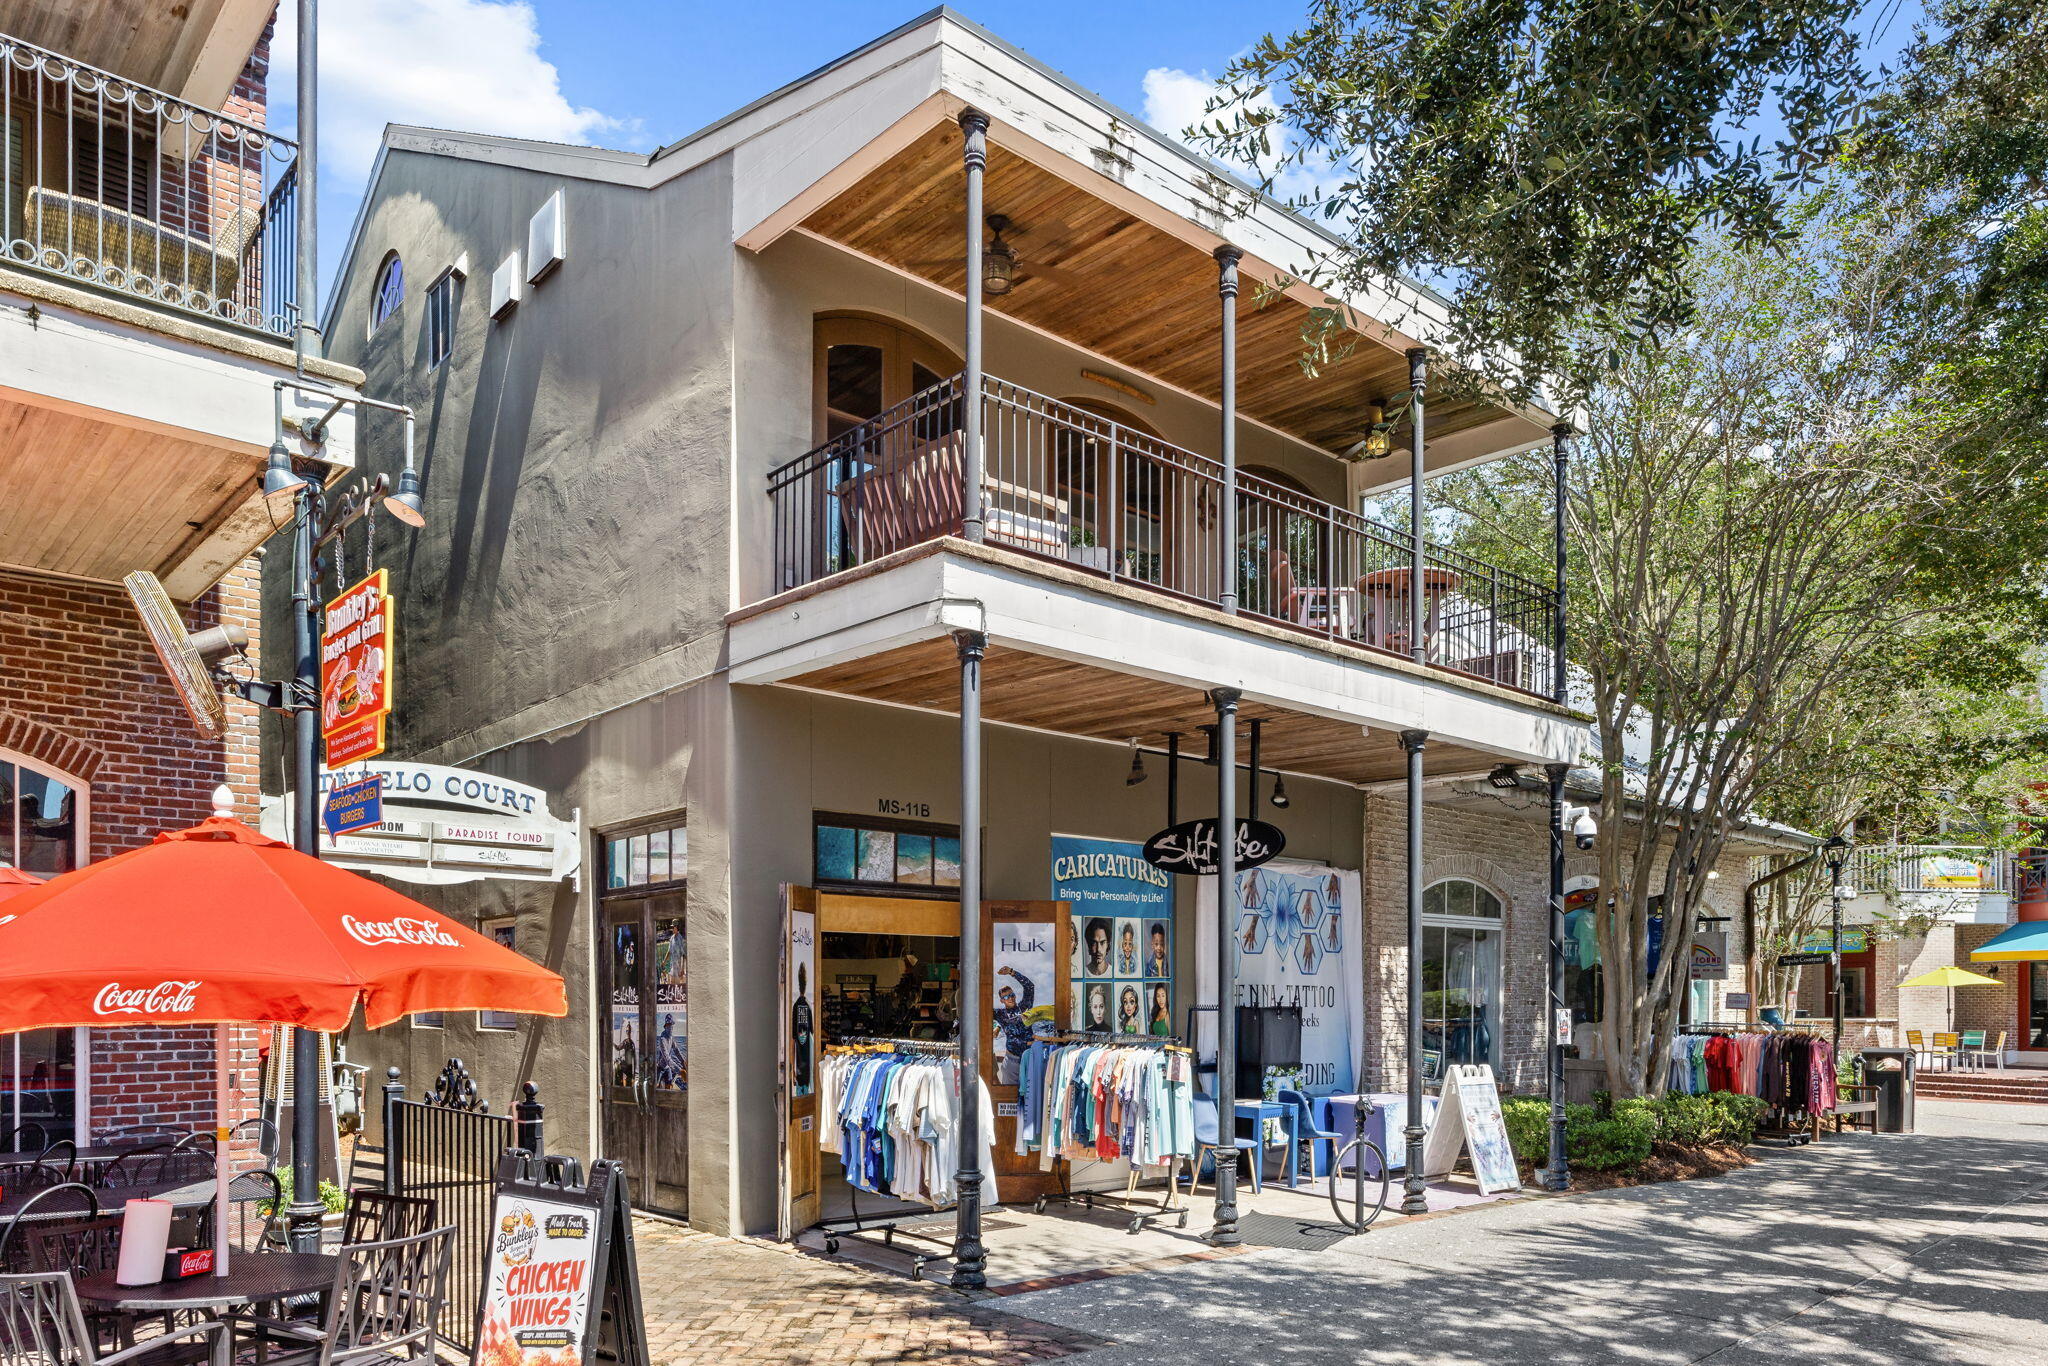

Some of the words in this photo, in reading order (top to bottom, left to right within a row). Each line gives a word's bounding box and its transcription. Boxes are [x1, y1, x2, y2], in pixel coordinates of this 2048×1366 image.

[444, 776, 536, 814] COURT
[341, 807, 365, 825] BURGERS
[878, 799, 930, 817] MS-11B
[448, 828, 498, 840] PARADISE
[507, 832, 542, 843] FOUND
[1054, 853, 1169, 889] CARICATURES
[1060, 888, 1081, 901] Bring
[1083, 889, 1099, 900] Your
[1100, 891, 1140, 904] Personality
[1141, 893, 1147, 902] to
[1148, 892, 1164, 903] Life!
[342, 915, 459, 947] Coca-Cola
[1001, 938, 1046, 952] Huk
[1695, 956, 1722, 964] FOUND
[94, 980, 203, 1015] Coca-Cola
[1286, 984, 1335, 1008] TATTOO
[1301, 1012, 1320, 1028] eeks
[1305, 1062, 1335, 1086] DING
[549, 1216, 566, 1228] Made
[496, 1224, 539, 1253] Bunkley's
[548, 1228, 561, 1237] MADE
[561, 1229, 568, 1237] TO
[182, 1253, 213, 1273] Coca-Cola
[506, 1259, 586, 1297] CHICKEN
[510, 1297, 572, 1328] WINGS
